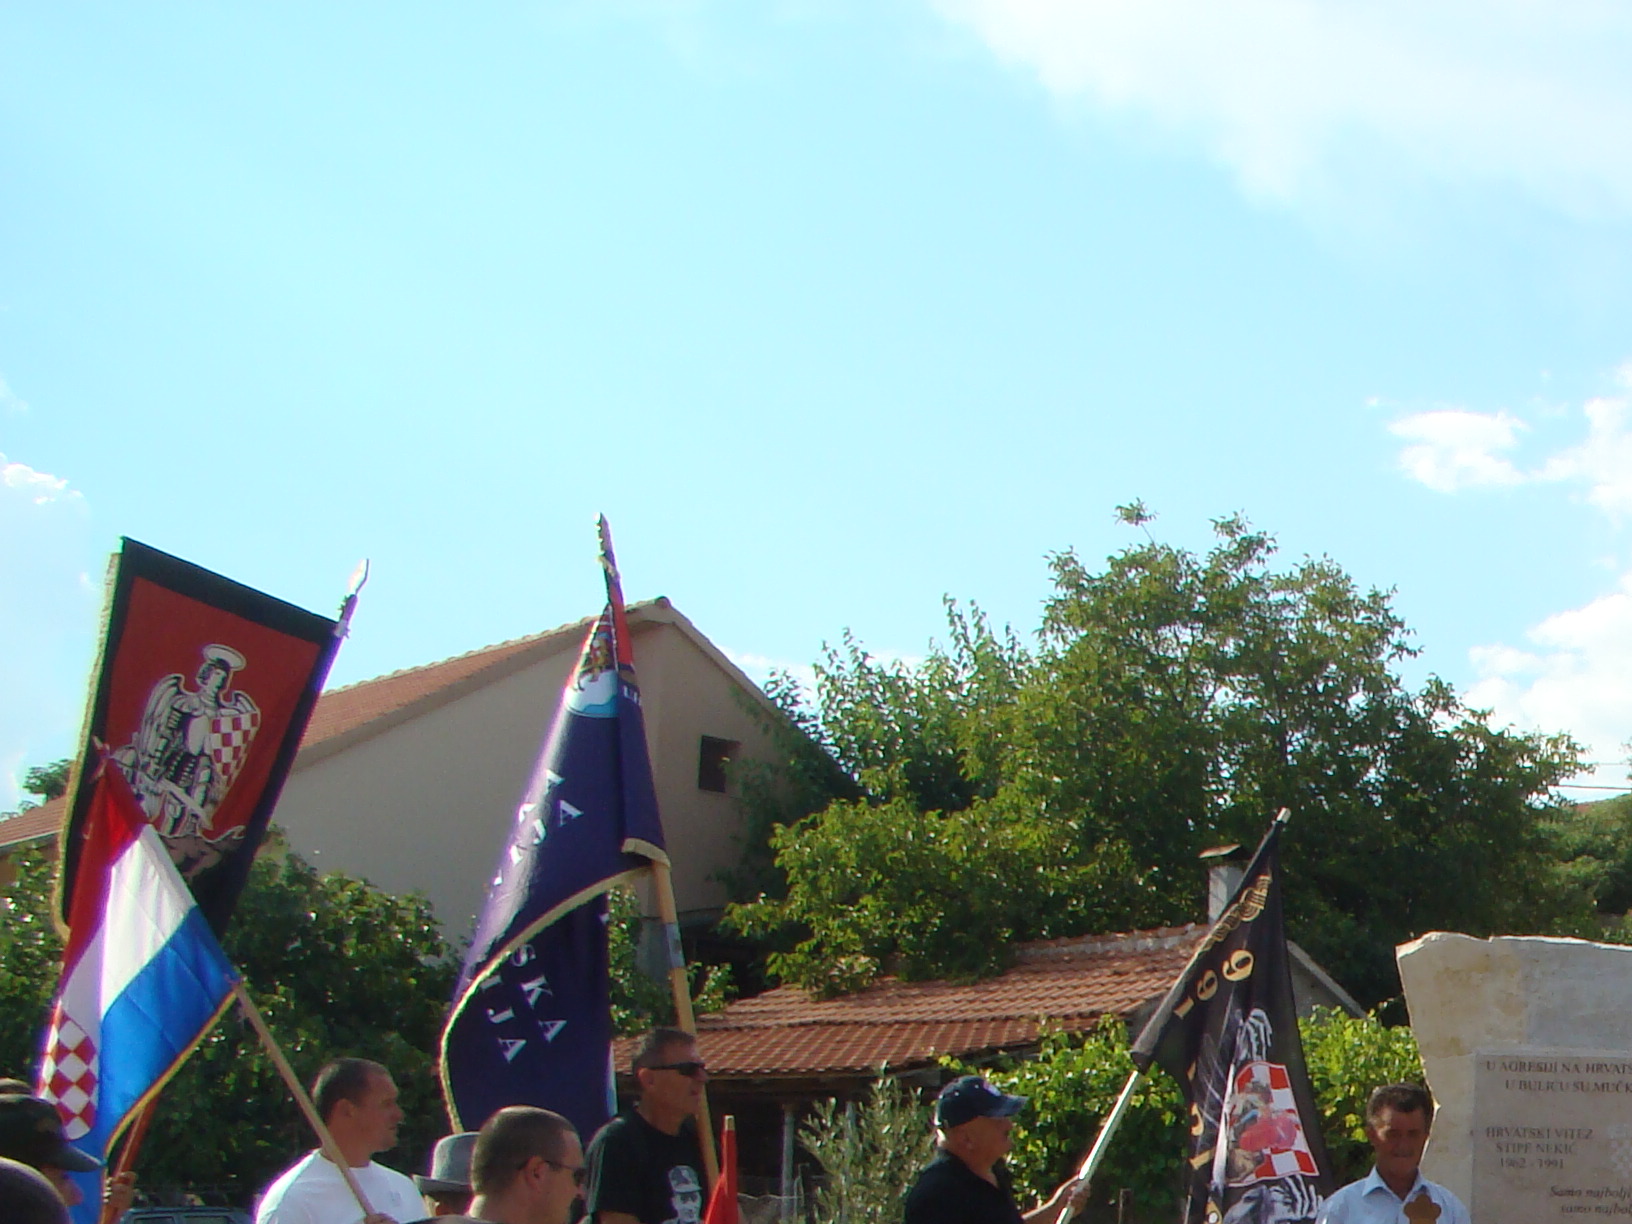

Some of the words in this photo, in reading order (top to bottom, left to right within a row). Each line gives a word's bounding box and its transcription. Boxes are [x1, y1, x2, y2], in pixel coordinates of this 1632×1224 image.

[1561, 1062, 1581, 1074] NA
[1485, 1126, 1551, 1139] HRVATSKI
[1554, 1128, 1594, 1140] VITEZ
